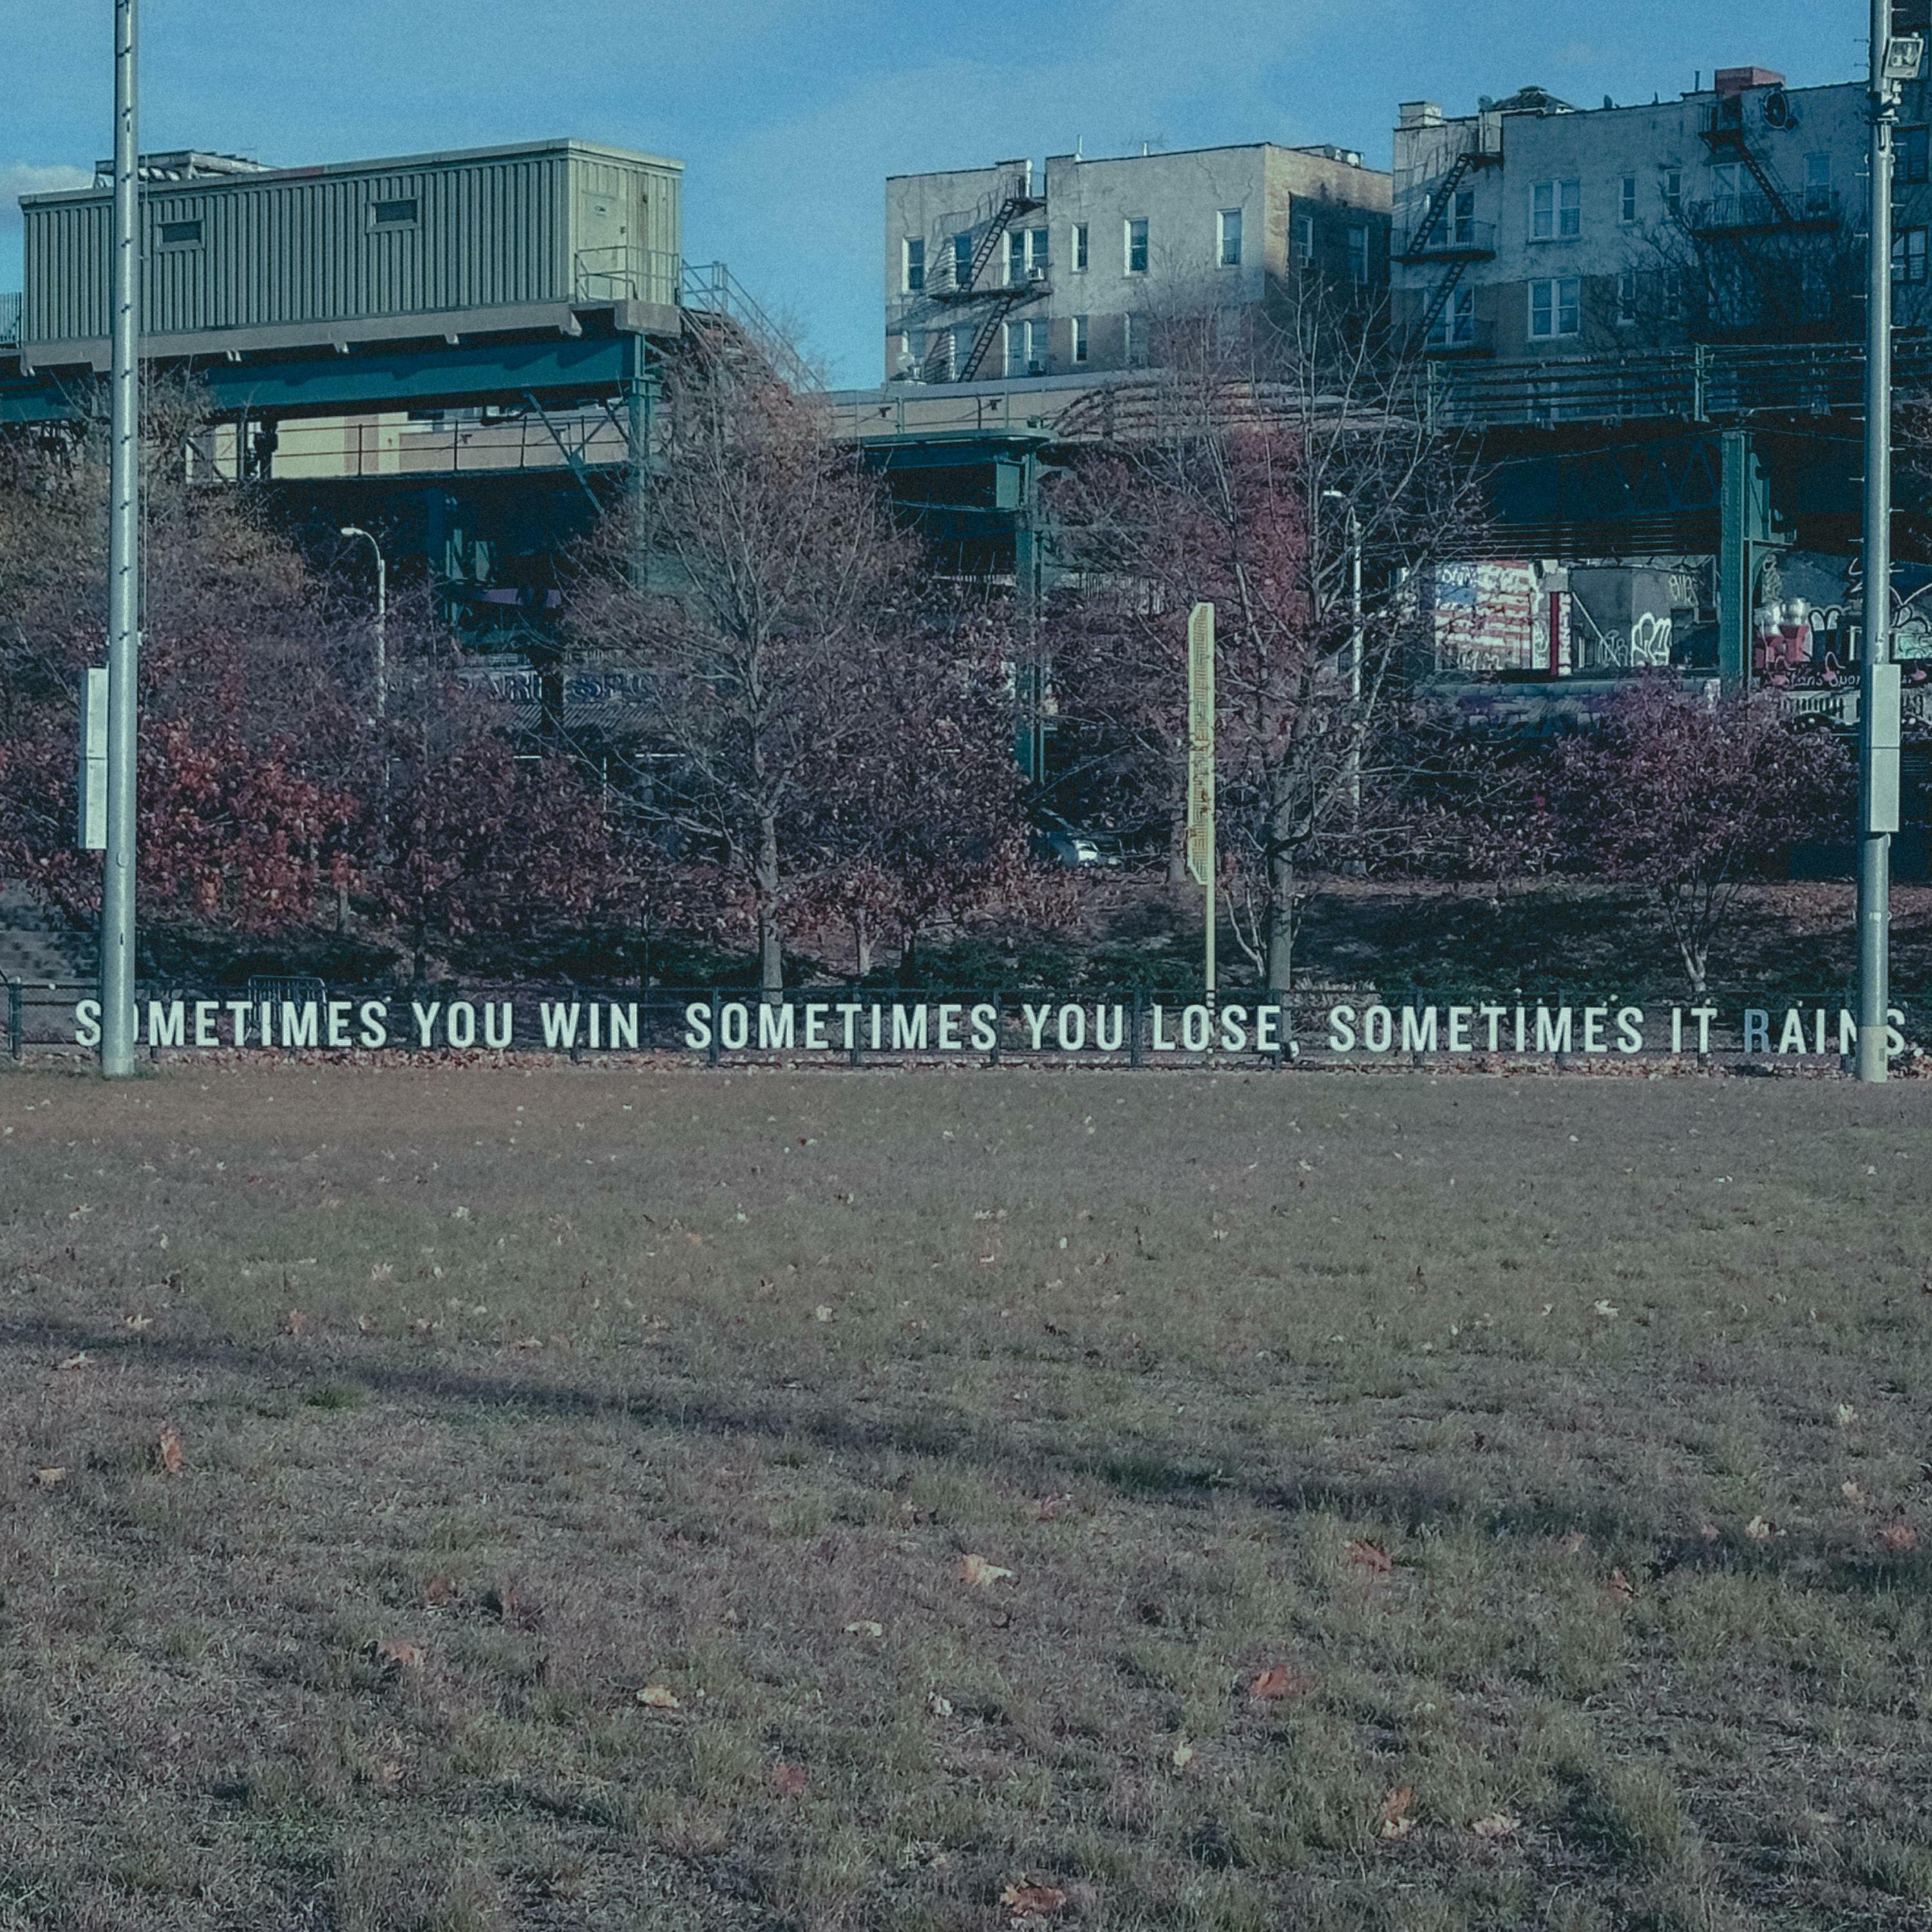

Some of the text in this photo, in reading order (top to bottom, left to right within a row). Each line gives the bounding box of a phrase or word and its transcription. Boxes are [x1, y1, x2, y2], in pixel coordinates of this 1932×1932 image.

[75, 999, 387, 1048] SMETIMES
[412, 1002, 513, 1051] YOU
[540, 1003, 639, 1048] WIN
[685, 1003, 997, 1050] SOMETIMES
[1023, 1003, 1123, 1051] YOU
[1329, 1005, 1644, 1054] SOMETIMES
[1672, 1007, 1718, 1054] IT
